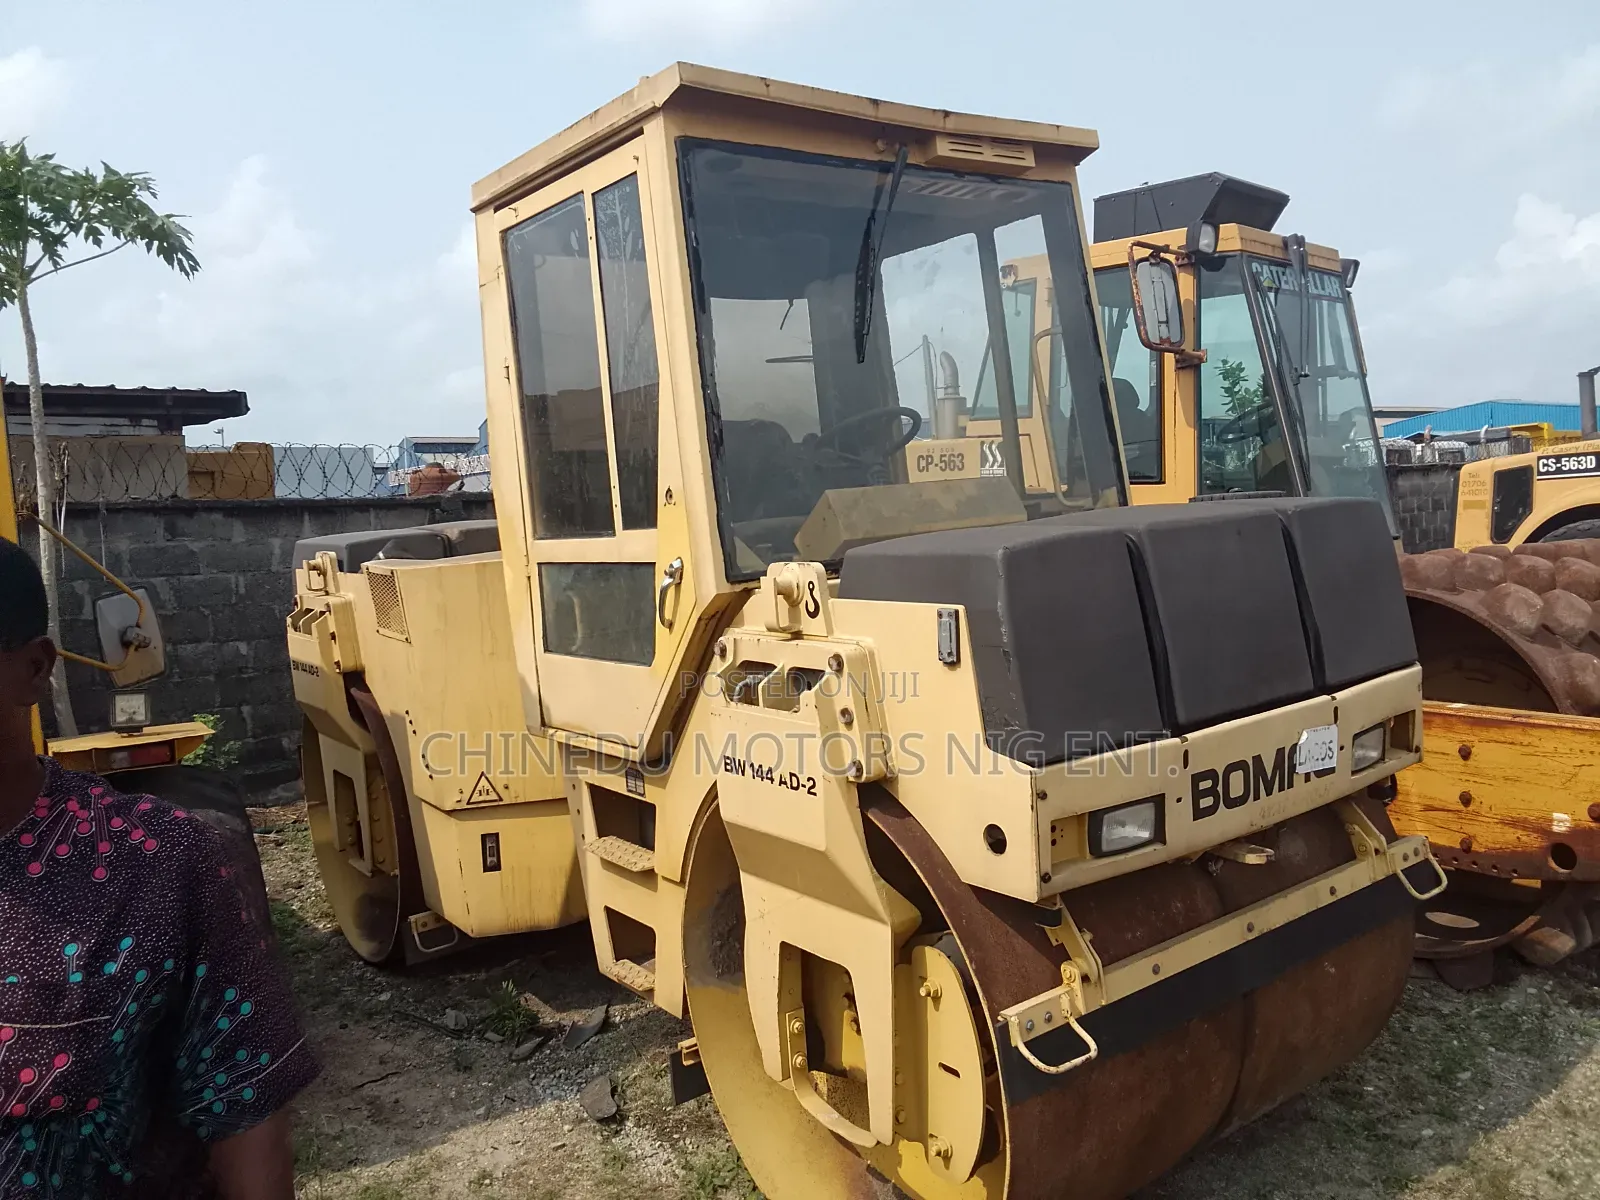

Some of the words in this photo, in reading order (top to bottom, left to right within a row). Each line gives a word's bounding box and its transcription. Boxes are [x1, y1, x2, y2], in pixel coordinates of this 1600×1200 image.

[1251, 262, 1343, 298] CATERILLAR
[916, 452, 965, 473] CP-563
[1539, 455, 1596, 472] CS-563D
[723, 754, 746, 777] BW
[749, 762, 775, 785] 144
[778, 771, 818, 797] AD-2
